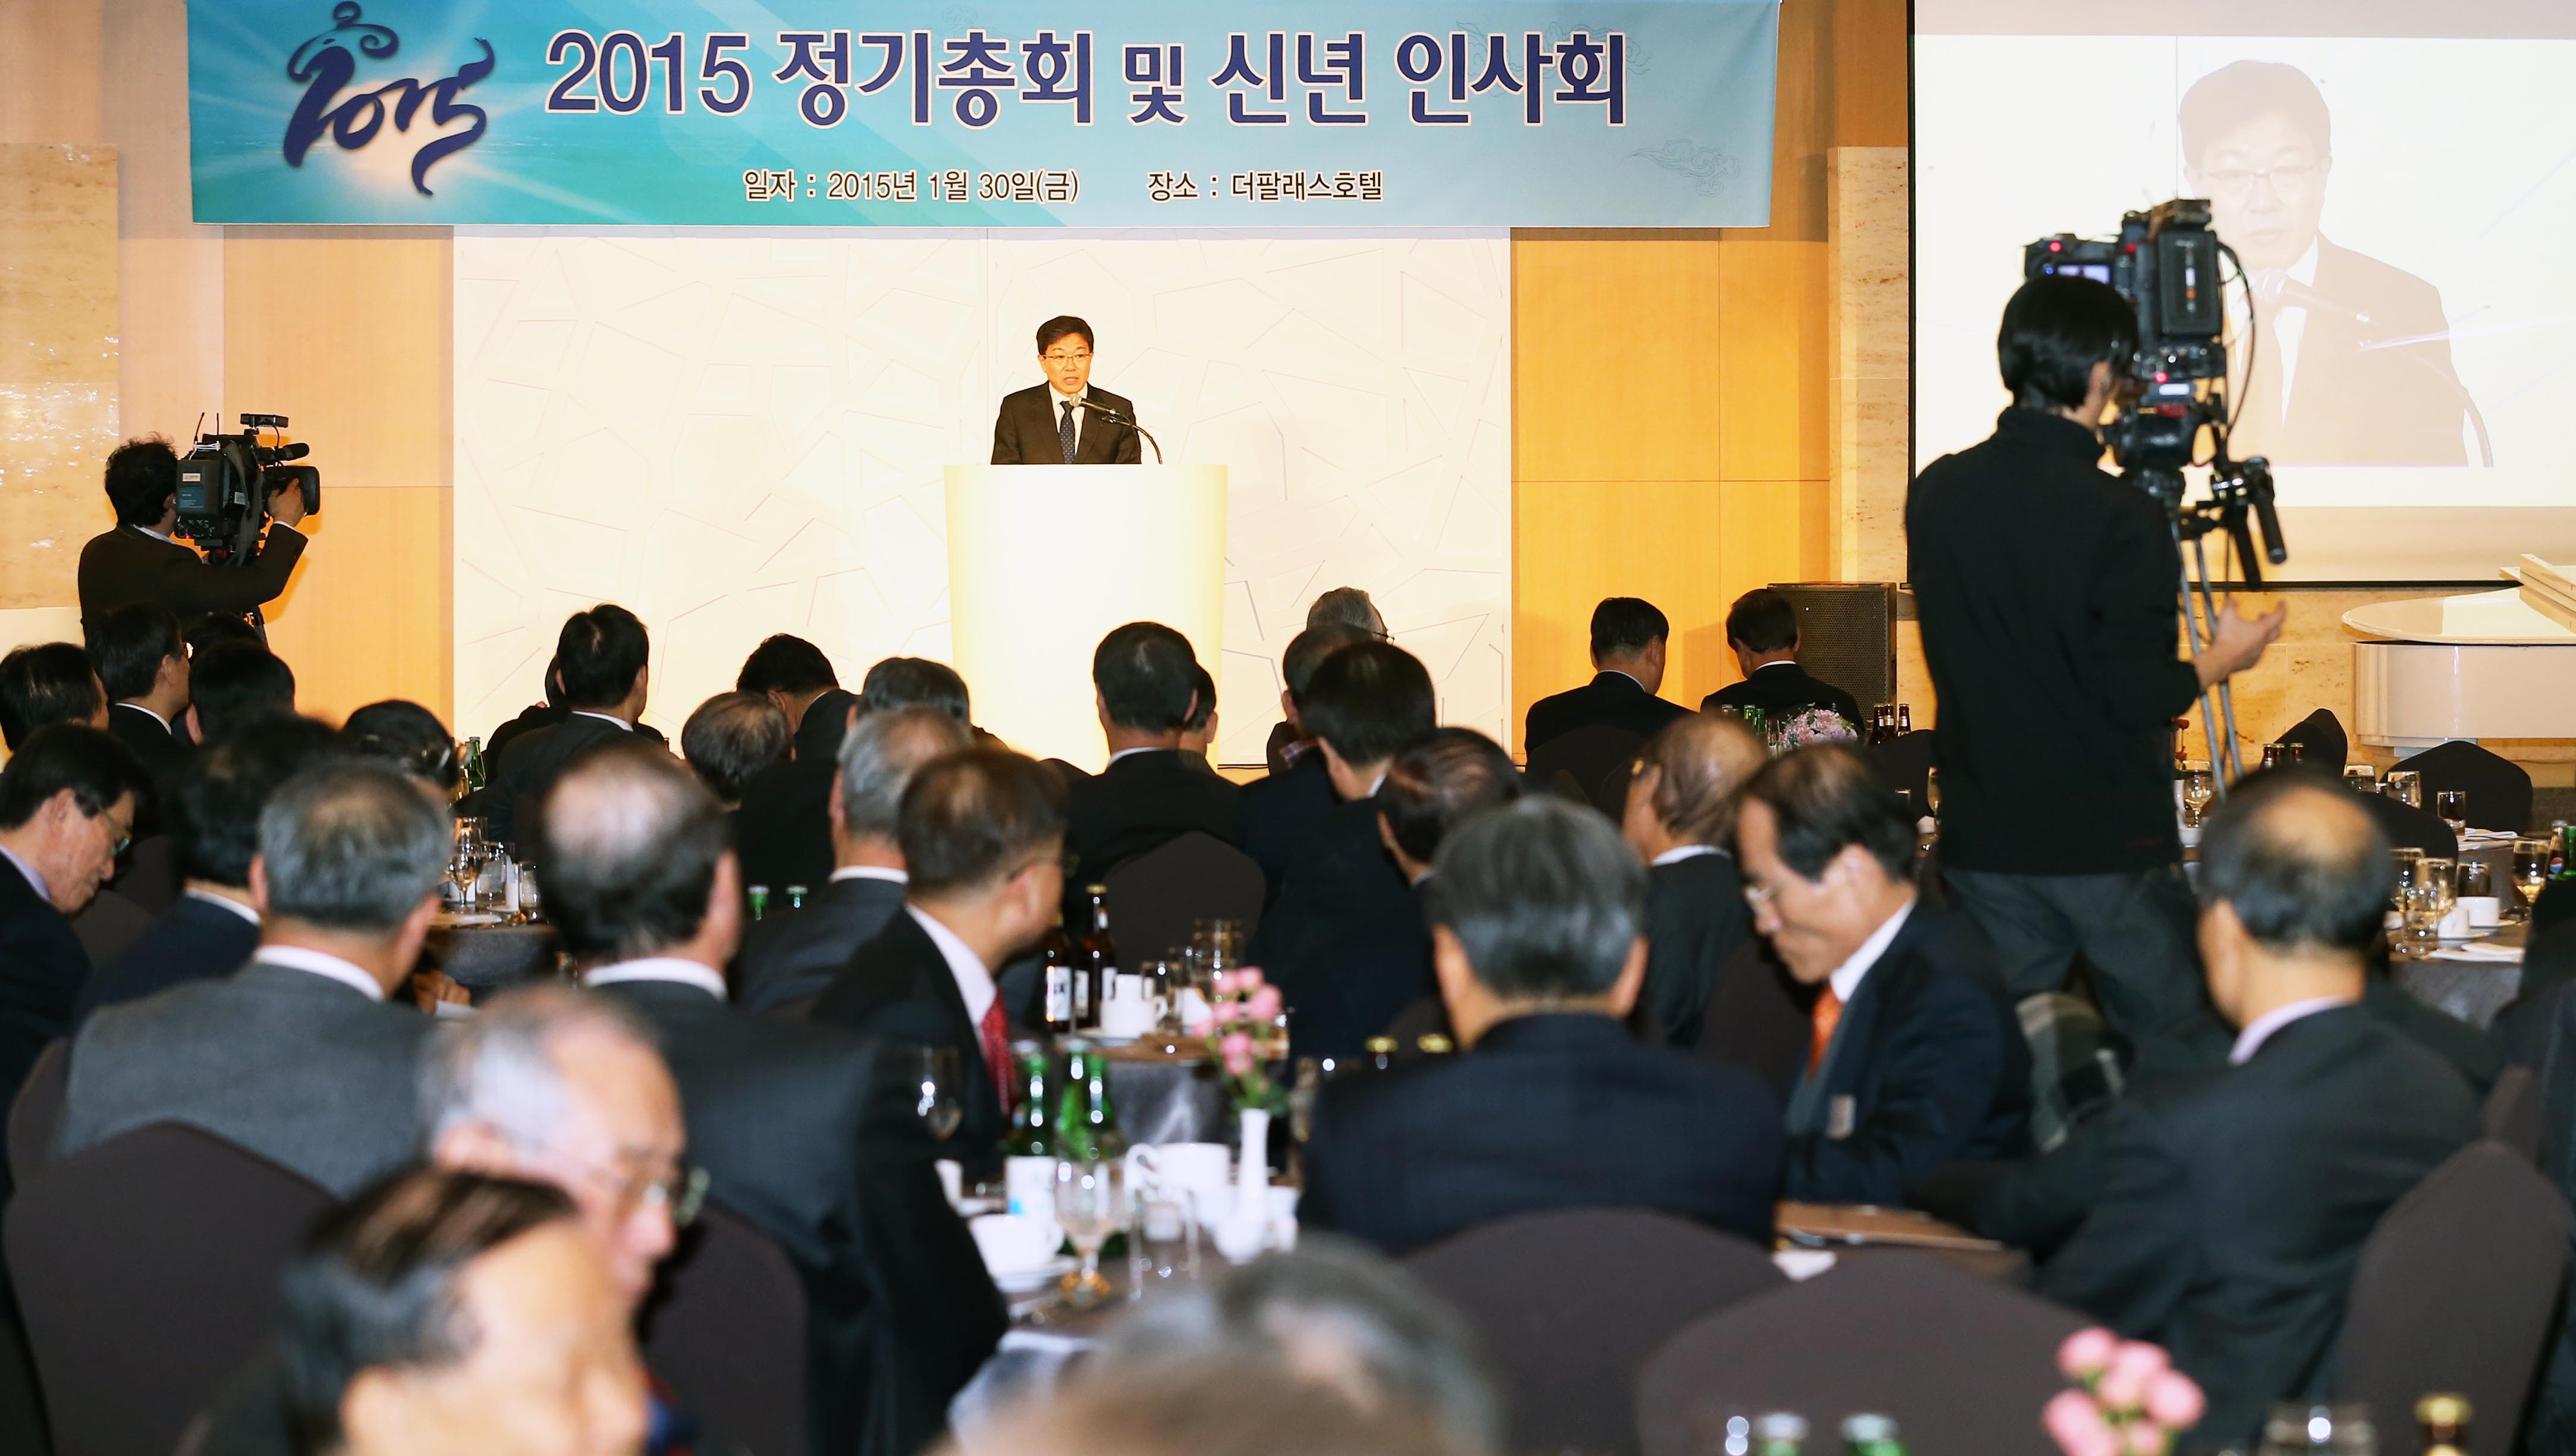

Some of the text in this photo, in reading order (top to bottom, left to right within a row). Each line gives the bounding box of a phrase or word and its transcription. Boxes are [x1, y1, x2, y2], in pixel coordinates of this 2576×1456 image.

[548, 32, 1624, 127] 2015 정기총회 및 신년 인사회
[744, 171, 796, 200] 일자
[828, 171, 916, 200] 2015년
[929, 171, 967, 201] 1월
[979, 169, 1079, 203] 30일(금)
[1148, 171, 1200, 202] 장소
[1232, 171, 1382, 201] 더팔래스호텔
